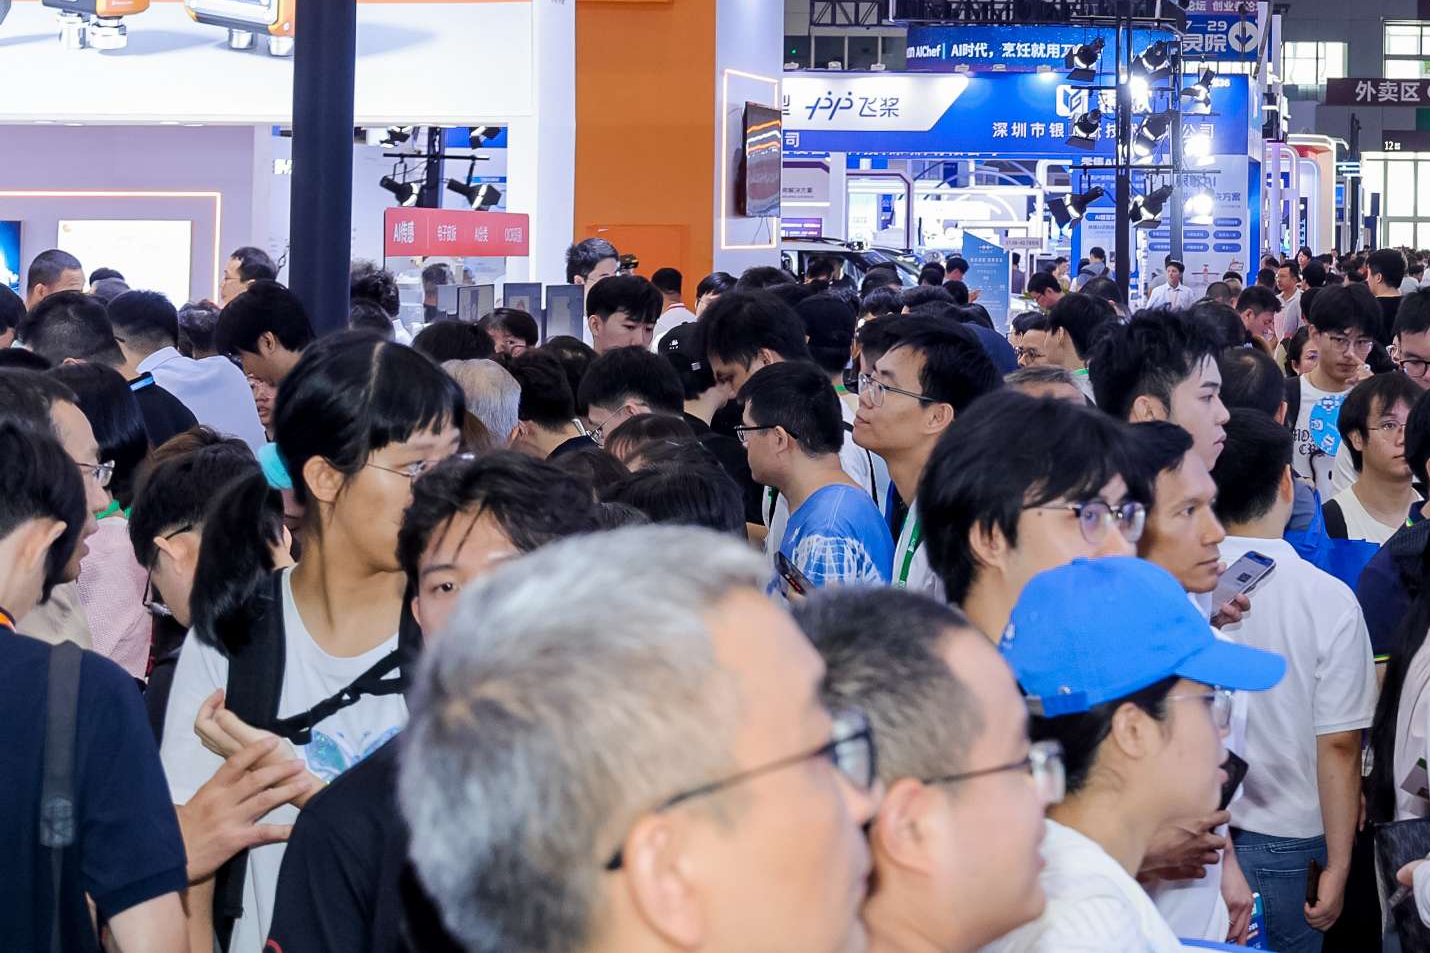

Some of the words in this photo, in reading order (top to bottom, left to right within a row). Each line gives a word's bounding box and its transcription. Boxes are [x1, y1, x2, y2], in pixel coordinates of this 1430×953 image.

[1355, 80, 1421, 103] 外卖区
[858, 97, 899, 118] 飞桨
[1384, 141, 1393, 151] 12
